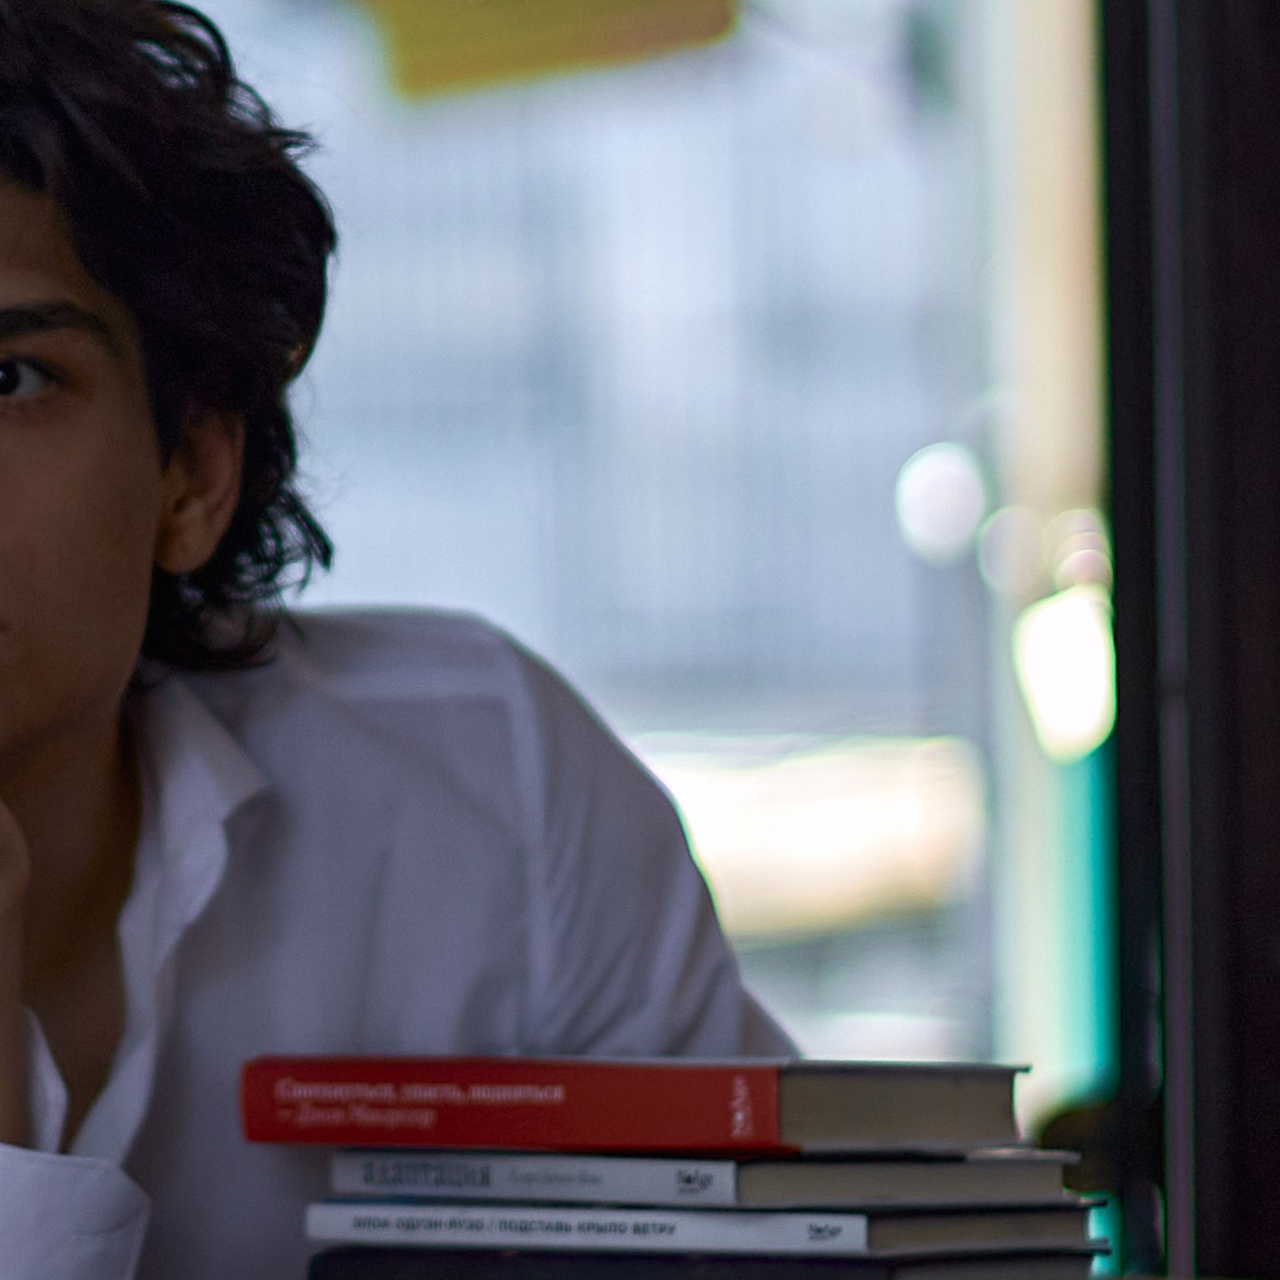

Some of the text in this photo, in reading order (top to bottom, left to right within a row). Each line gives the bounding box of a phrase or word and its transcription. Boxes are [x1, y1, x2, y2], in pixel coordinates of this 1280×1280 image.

[499, 1220, 572, 1234] ПОДСТАВЬ
[577, 1221, 628, 1235] КРЫЛО
[633, 1223, 676, 1236] ВЕТРУ
